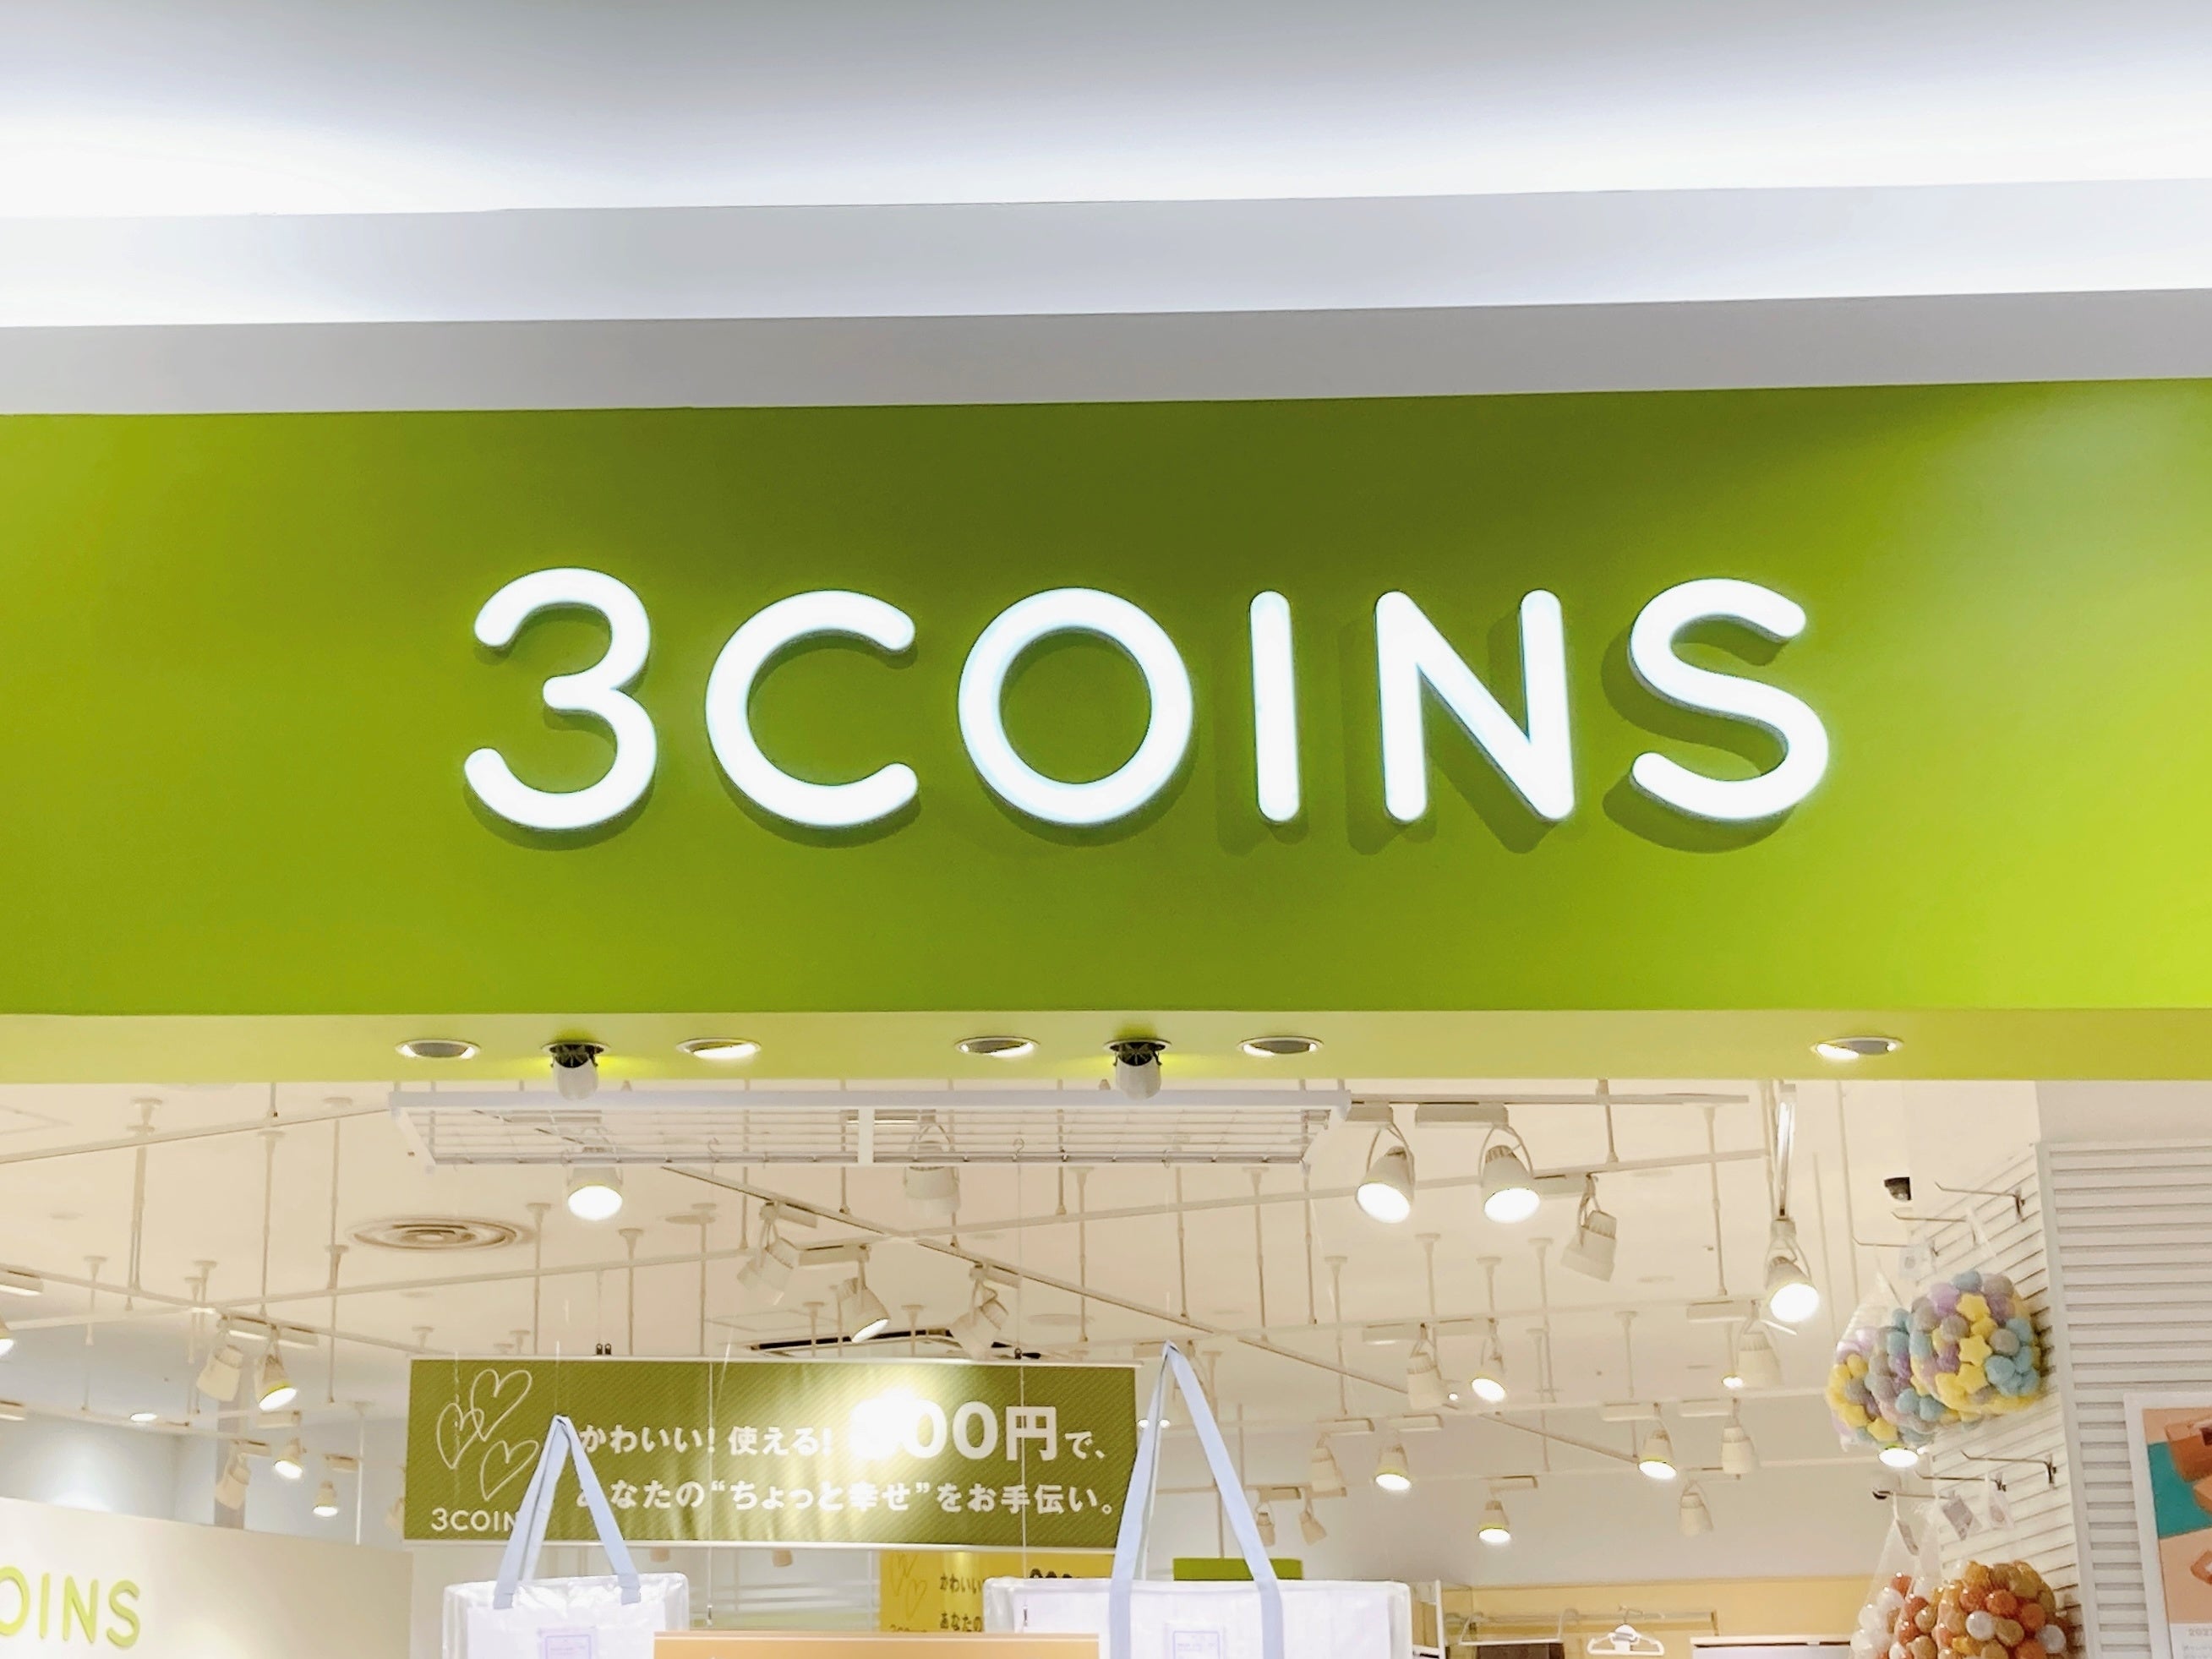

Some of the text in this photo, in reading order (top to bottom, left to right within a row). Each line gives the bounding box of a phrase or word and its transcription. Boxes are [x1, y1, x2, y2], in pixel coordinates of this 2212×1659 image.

[464, 567, 1831, 830] 3COINS
[848, 1399, 1106, 1462] 00円で、
[431, 1507, 516, 1531] 3COIN
